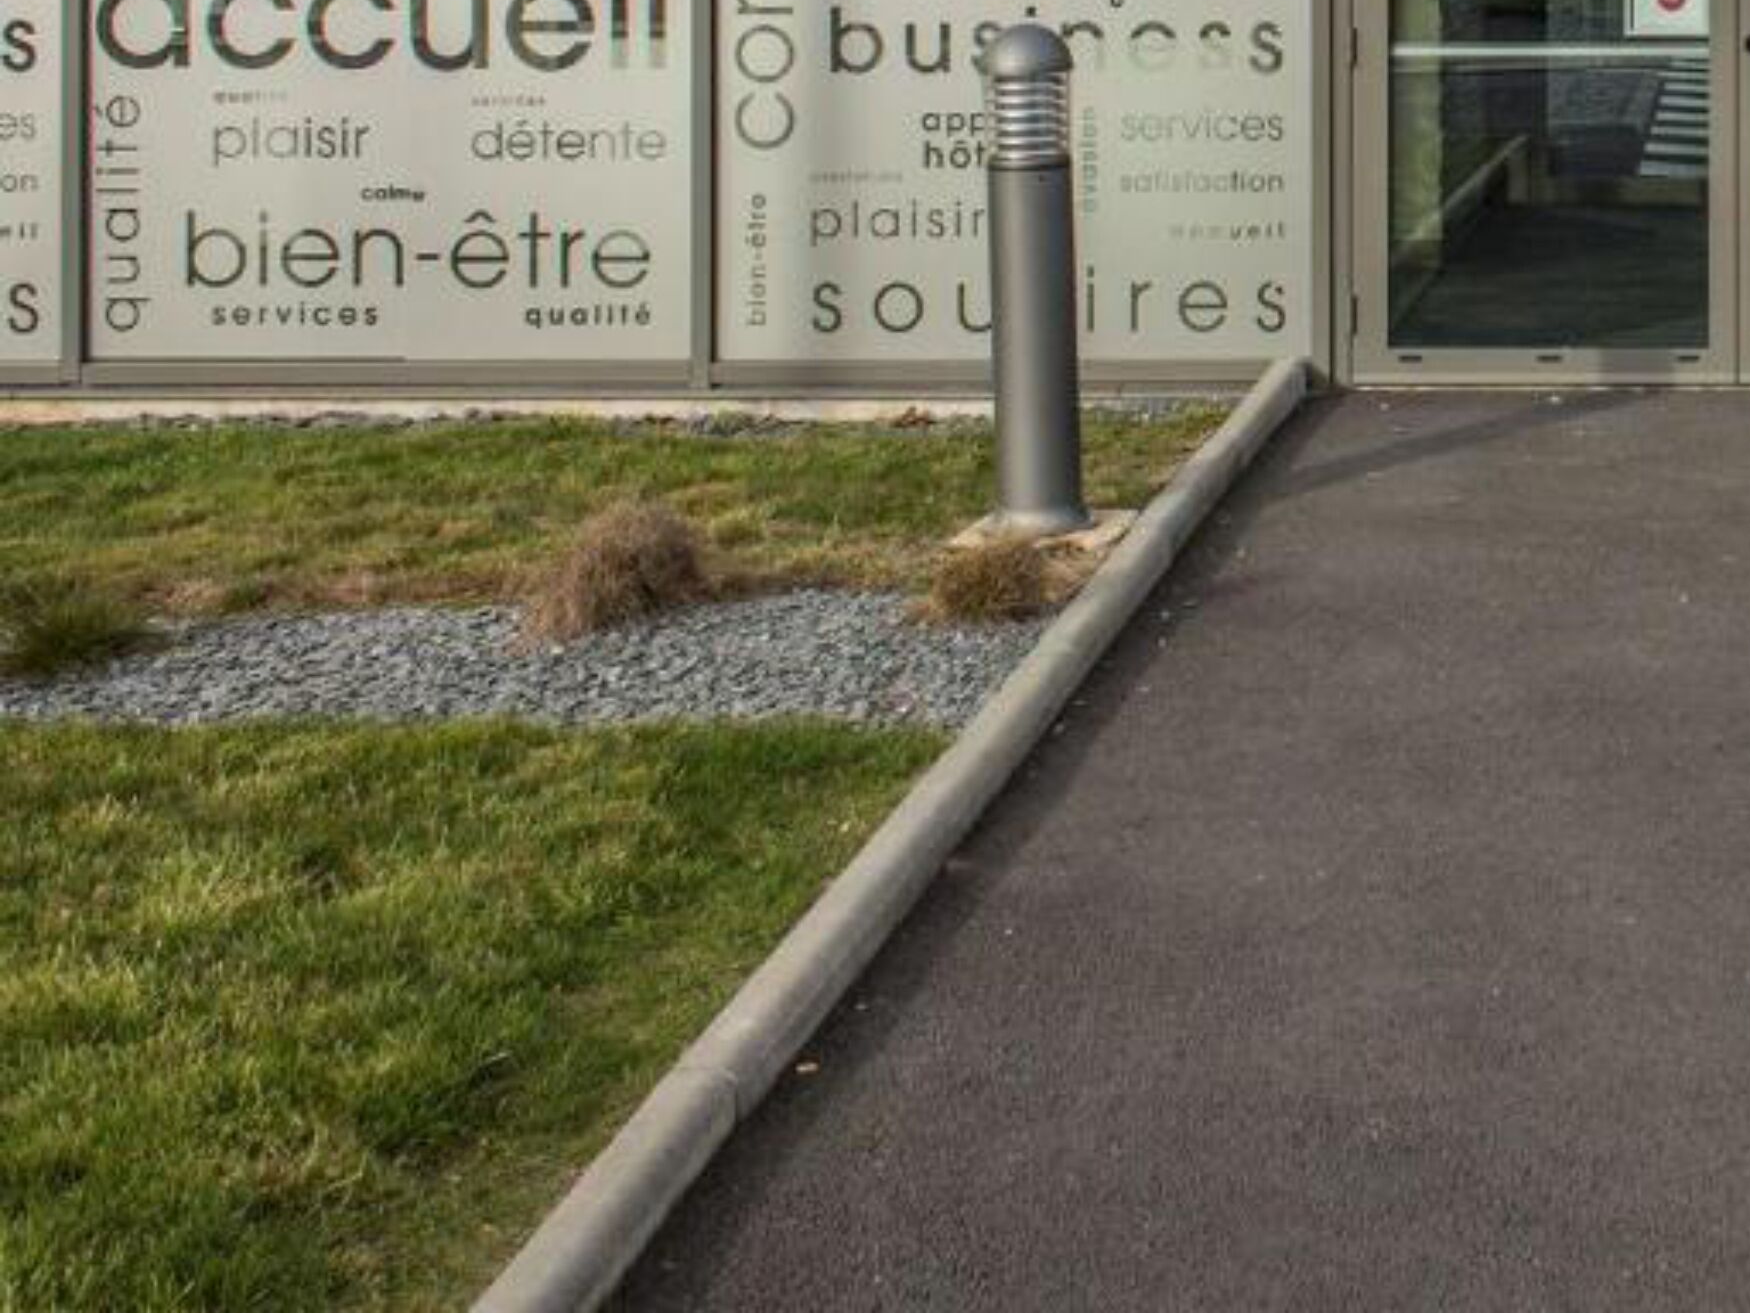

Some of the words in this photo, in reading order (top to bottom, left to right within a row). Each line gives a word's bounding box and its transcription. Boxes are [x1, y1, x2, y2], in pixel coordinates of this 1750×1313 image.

[213, 116, 369, 166] plaisir
[471, 120, 667, 160] détente
[95, 95, 151, 332] qualité
[810, 200, 986, 247] plaisir
[186, 209, 651, 289] bien-être
[212, 303, 378, 326] services
[525, 302, 651, 329] qualité
[812, 265, 1286, 332] souires
